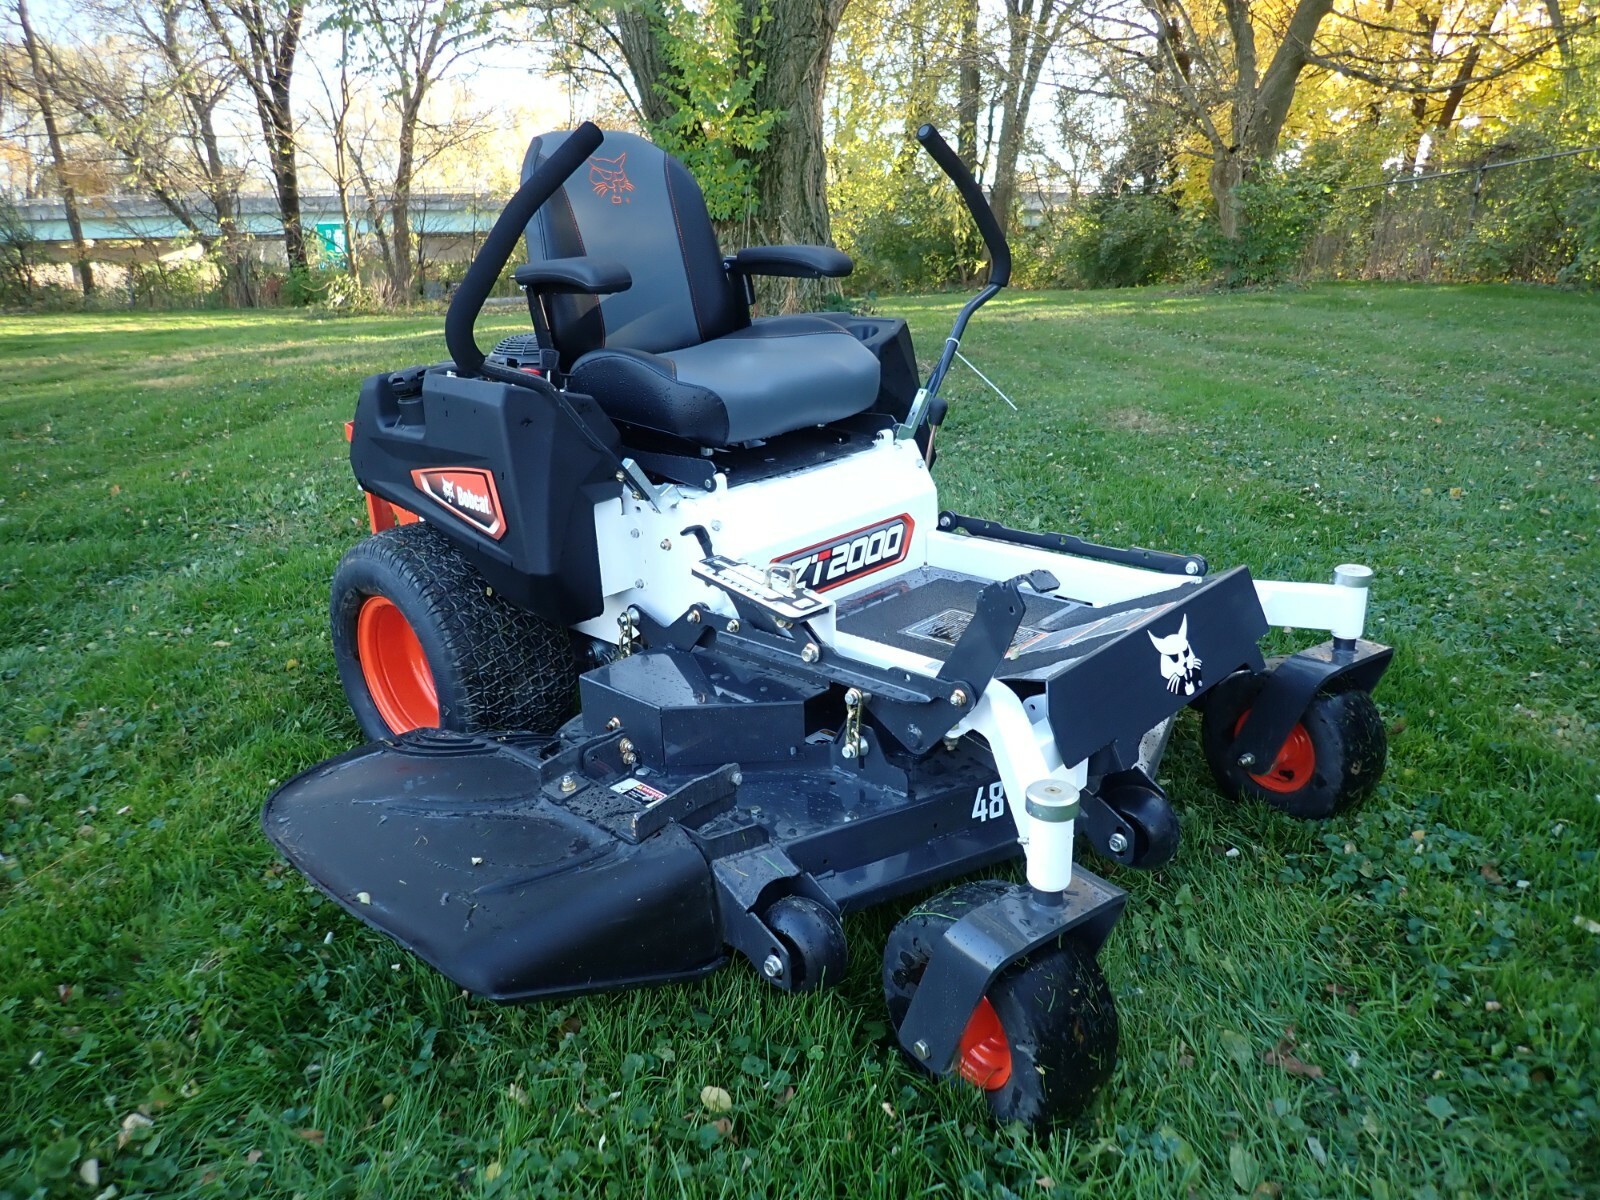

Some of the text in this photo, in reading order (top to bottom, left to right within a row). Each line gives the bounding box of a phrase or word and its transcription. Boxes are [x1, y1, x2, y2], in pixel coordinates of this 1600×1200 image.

[457, 486, 489, 515] Bobcat
[791, 523, 904, 588] ZT2000
[971, 781, 1004, 822] 48
